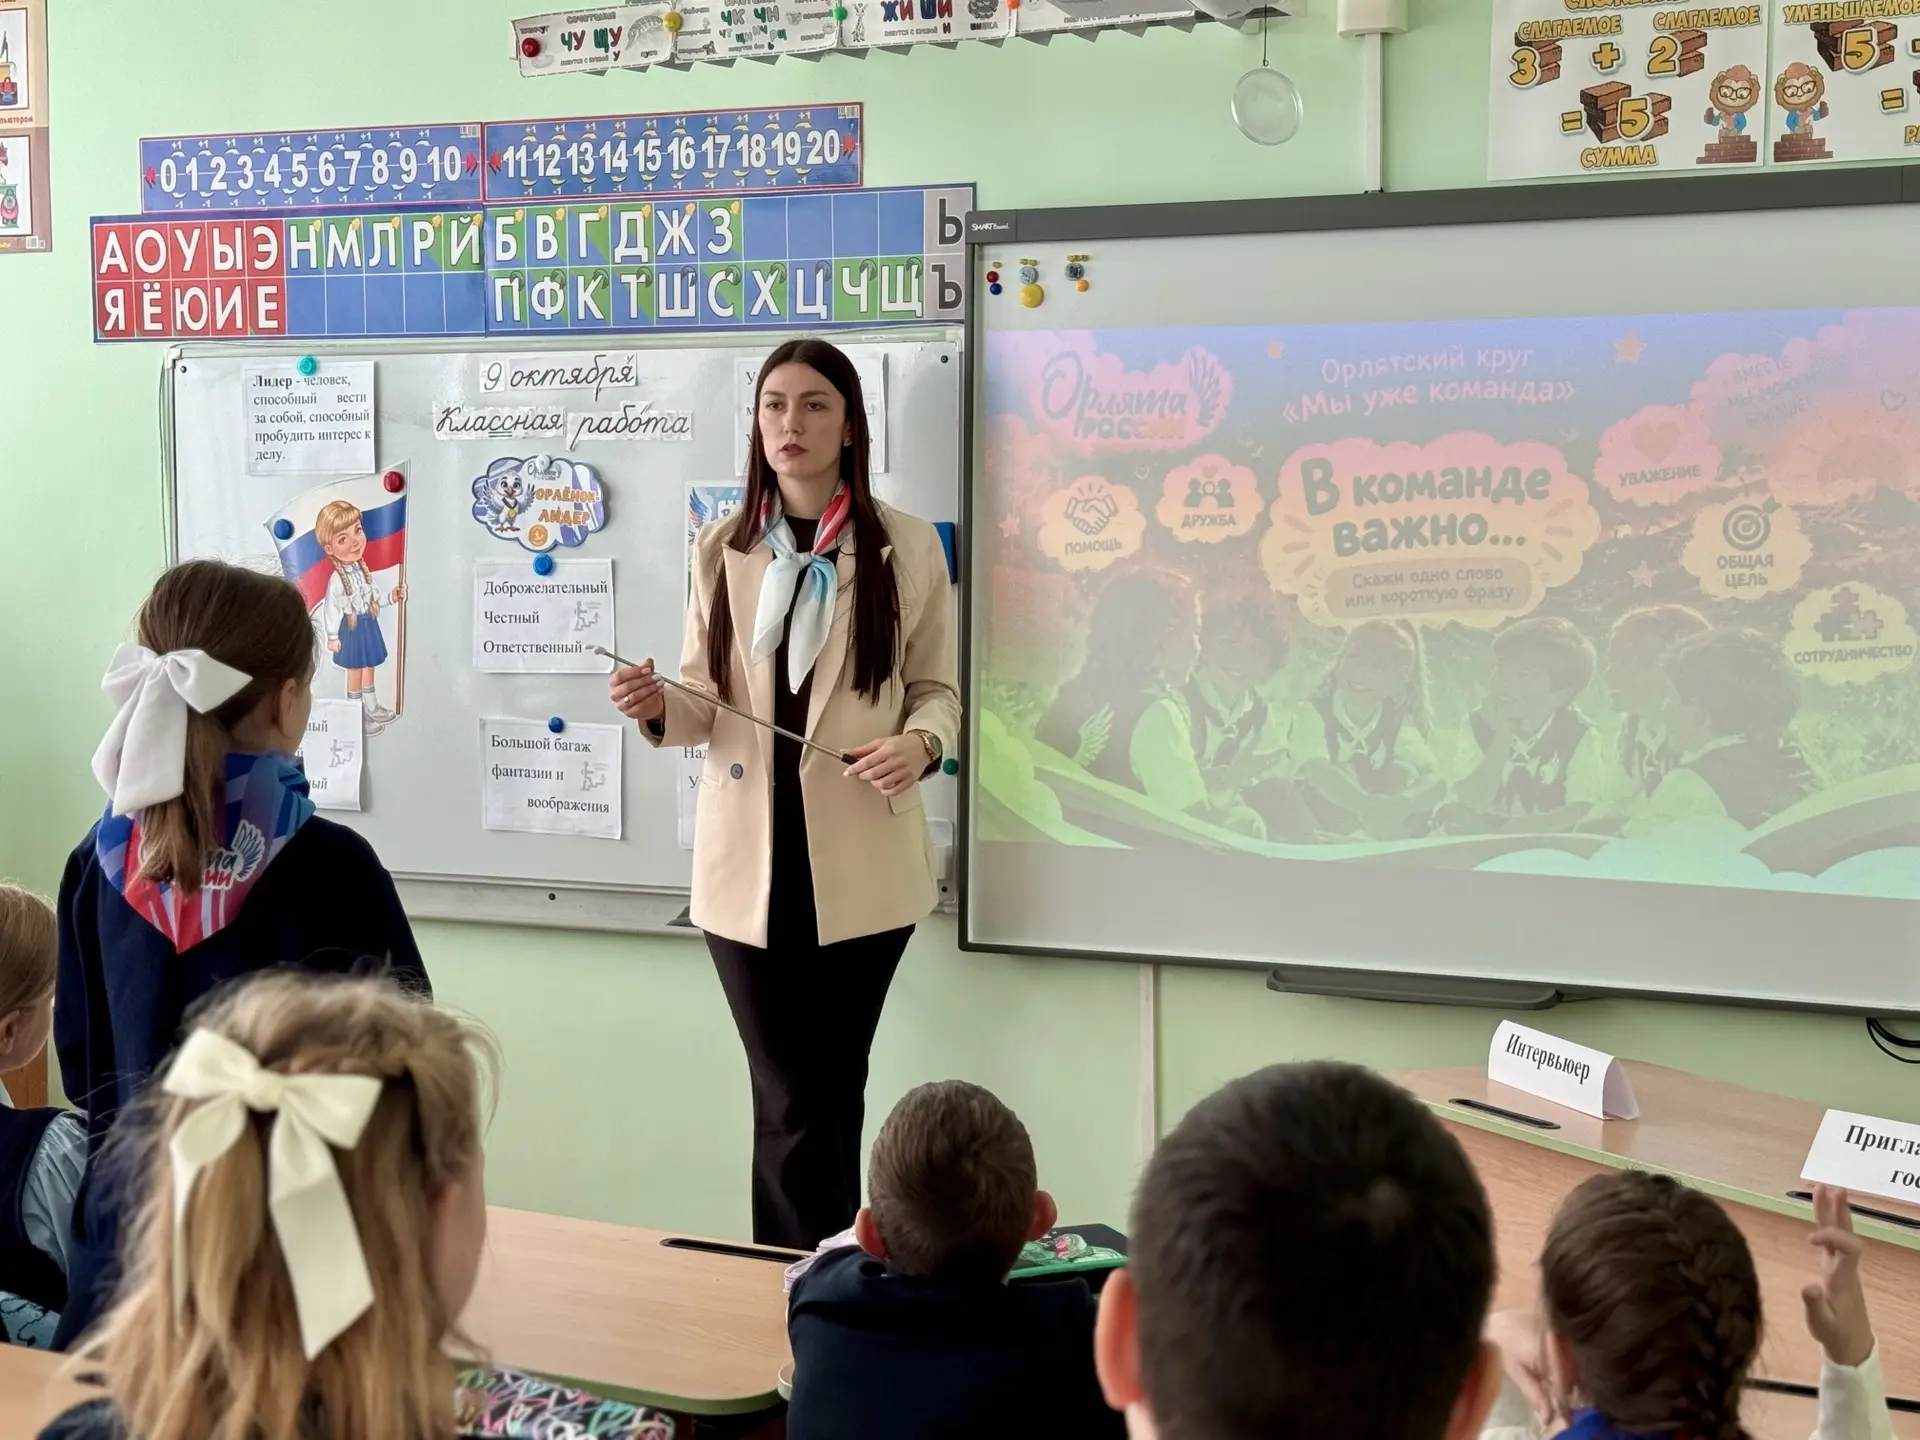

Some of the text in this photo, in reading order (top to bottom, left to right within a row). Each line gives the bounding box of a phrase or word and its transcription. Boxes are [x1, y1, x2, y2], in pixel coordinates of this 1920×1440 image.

[721, 9, 745, 26] ЧК
[754, 6, 780, 23] ЧН
[881, 0, 953, 22] ЖИ ШИ
[1654, 5, 1761, 30] СЛАГАЕМОЕ
[943, 23, 951, 34] И
[1518, 15, 1622, 40] СЛАГАЕМОЕ
[560, 25, 622, 54] ЧУ ЩУ
[1844, 28, 1875, 70] 5
[1509, 38, 1676, 86] 3 2
[525, 112, 811, 134] +1 +1 +1 +1 +1 +1 +1 +1 +1 +1
[1617, 98, 1650, 138] 5
[171, 130, 430, 149] +1 +1 +1 +1 +1 +1 +1 +1 +1 +1
[503, 129, 840, 178] 11 12 13 14 15 16 17 18 19 20
[1580, 144, 1656, 167] СУММА
[160, 146, 462, 192] 0 1 2 3 4 5 6 7 8 9 10
[495, 198, 963, 263] Б В Г Д Ж З Ь
[99, 216, 481, 274] А О У Ы Э Н М Л Р Й
[494, 264, 962, 321] П Ф К Т Ш С Х Ц Ч Щ Ъ
[104, 282, 279, 331] Я Ё Ю И Е
[484, 362, 502, 390] 9
[1321, 346, 1534, 387] Орлятский круг
[252, 375, 351, 390] Лидер человек,
[1042, 350, 1188, 437] Орлята
[254, 392, 366, 406] способный вести
[1283, 379, 1575, 423] «Мы уже команда»
[254, 409, 370, 424] за собой, способный
[255, 429, 370, 445] пробудить интерес к
[436, 405, 690, 451] Классная работа
[255, 450, 286, 462] делу.
[1618, 464, 1701, 486] УВАЖЕНИЕ
[1300, 457, 1552, 517] В команде
[538, 508, 590, 525] ЛИДЕР
[1181, 513, 1236, 530] ДРУЖБА
[1065, 538, 1122, 555] ПОМОЩЬ
[1332, 513, 1525, 558] важно...
[1717, 555, 1774, 571] ОБЩАЯ
[484, 581, 608, 597] Доброжелательный
[1352, 568, 1504, 589] Скажи одно слово
[1725, 573, 1768, 589] ЦЕЛЬ
[1345, 584, 1514, 609] или короткую фразу
[484, 610, 539, 624] Честный
[483, 640, 582, 654] Ответственный
[1794, 645, 1913, 665] СОТРУДНИЧЕСТВО
[492, 734, 592, 753] Большой багаж
[492, 764, 564, 780] фантазии и
[527, 797, 610, 814] воображения
[1505, 1033, 1590, 1085] Интервьюер
